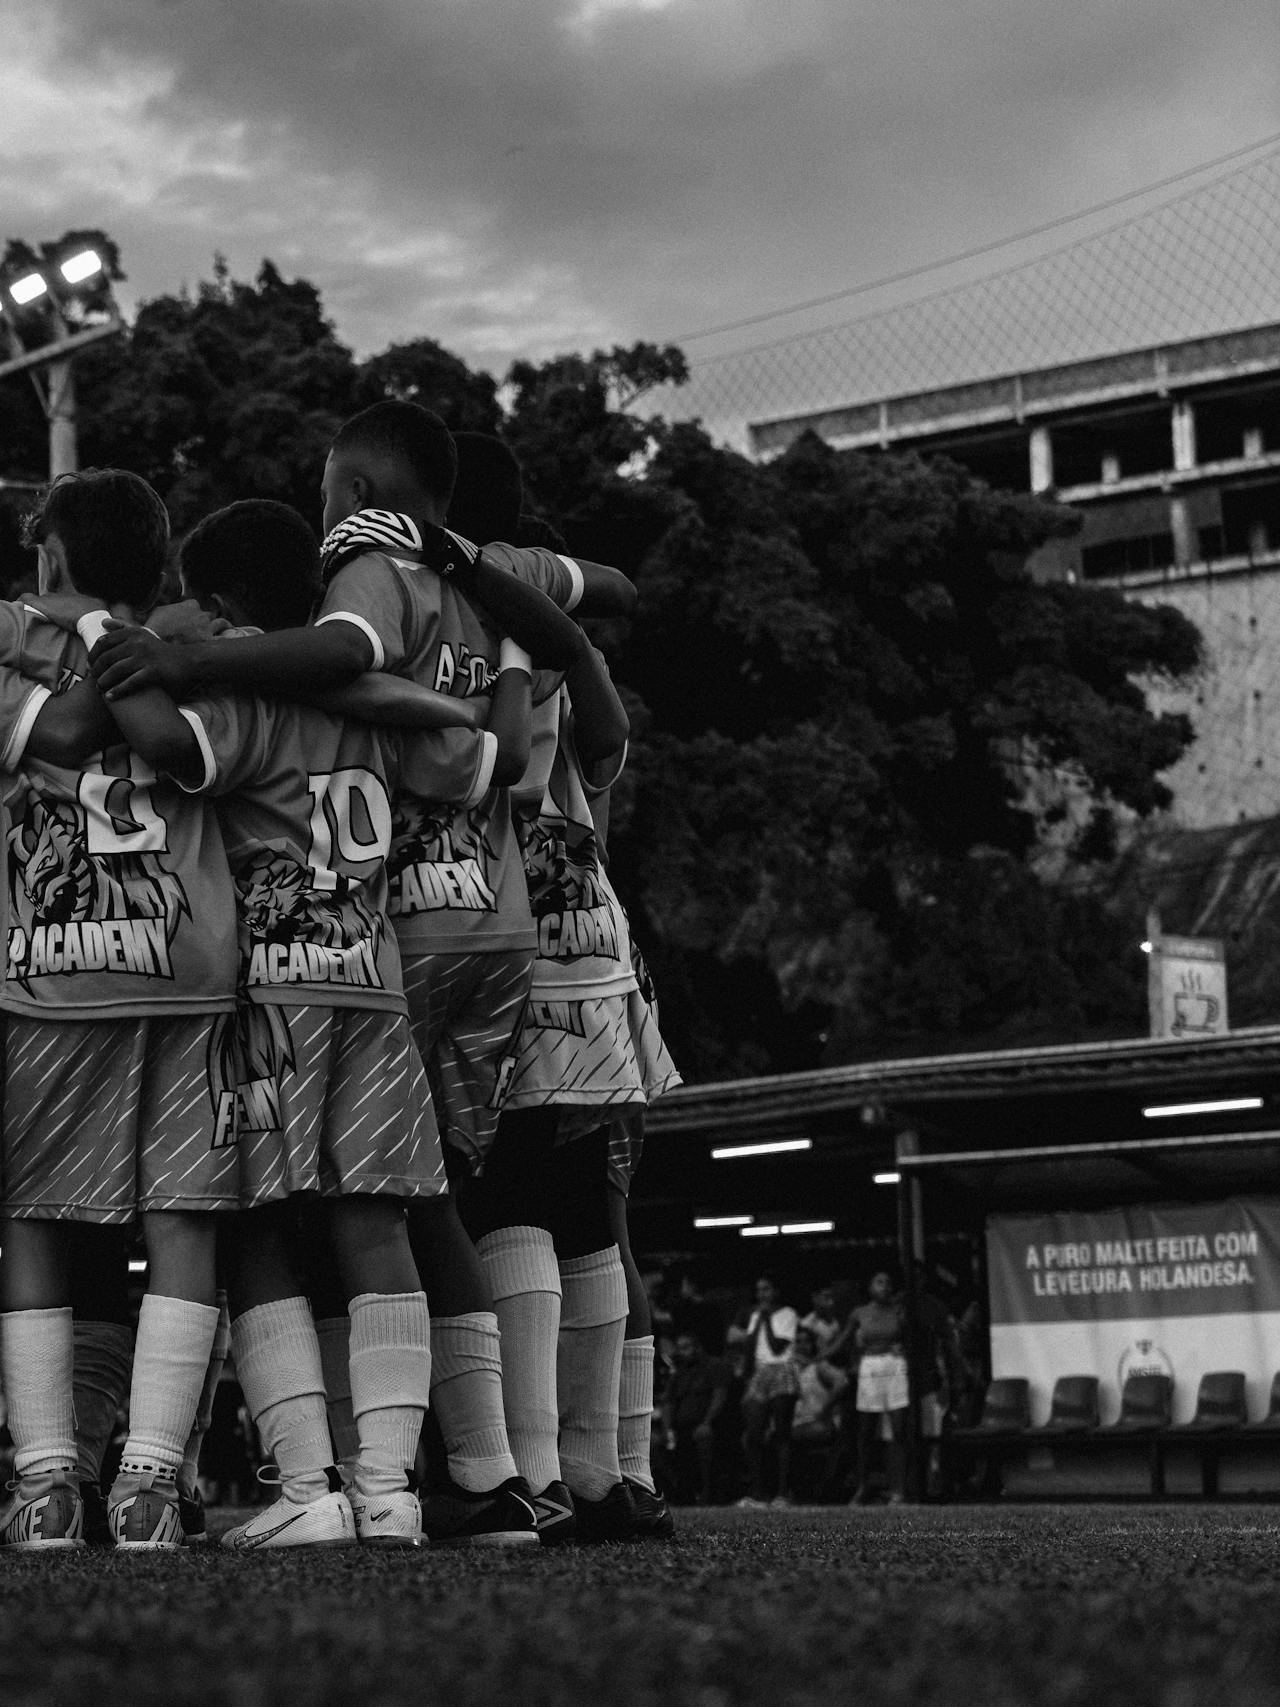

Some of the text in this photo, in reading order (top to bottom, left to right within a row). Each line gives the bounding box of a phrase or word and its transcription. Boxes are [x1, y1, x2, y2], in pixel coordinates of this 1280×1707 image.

[307, 766, 392, 891] 10
[389, 859, 498, 916] CADEMY
[27, 917, 173, 980] ACADEMY
[246, 938, 384, 989] ACADEMY
[1026, 1245, 1040, 1270] A
[1095, 1237, 1154, 1265] MALTE
[1156, 1233, 1211, 1263] FEITA
[1214, 1230, 1259, 1258] COM
